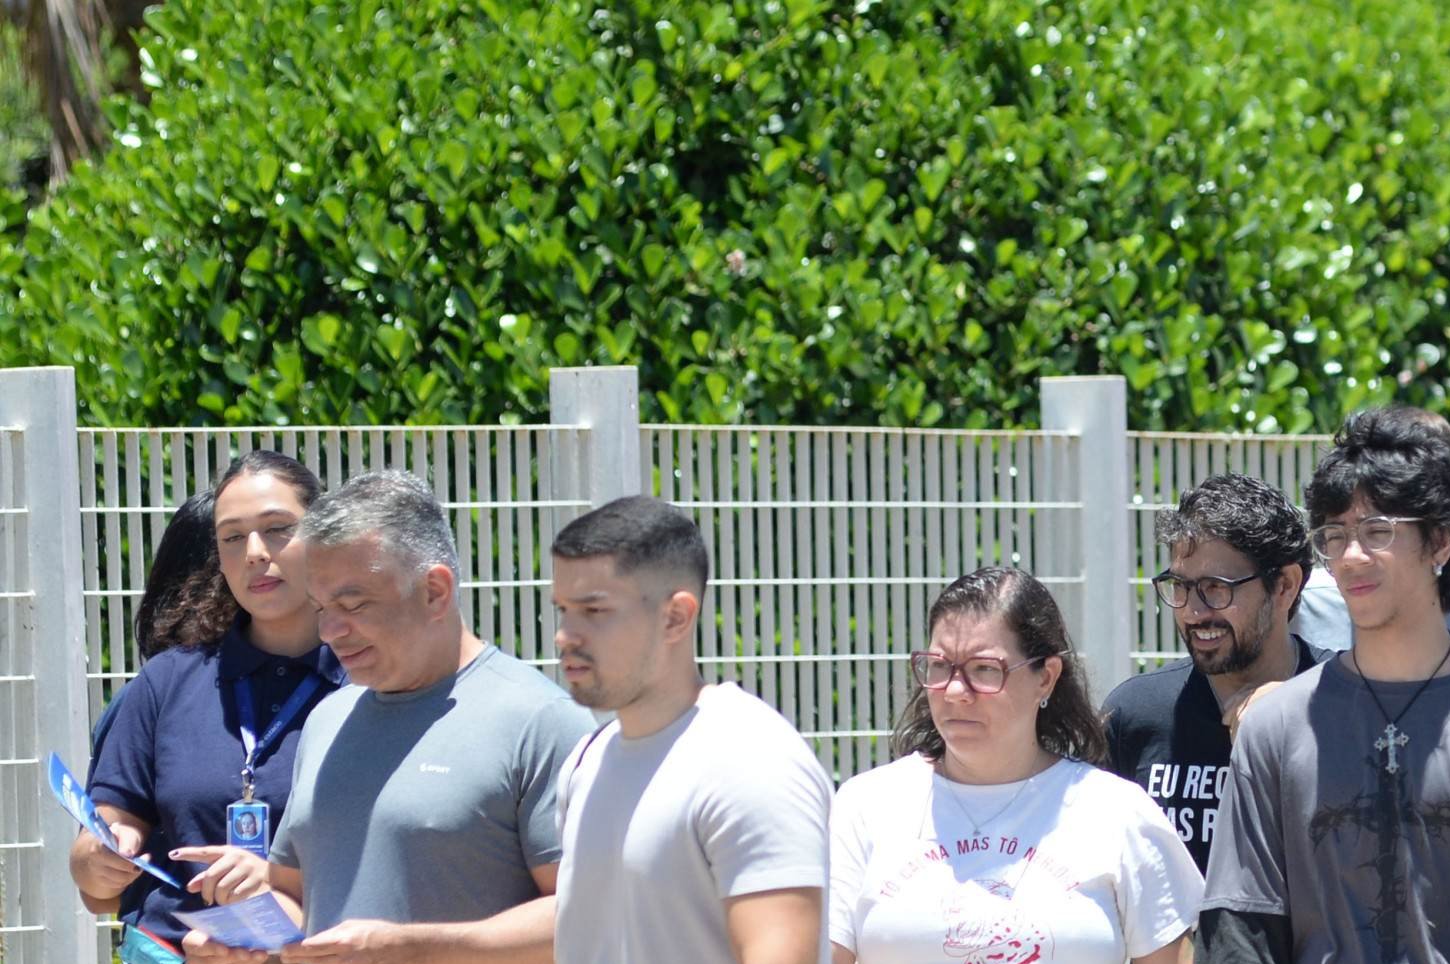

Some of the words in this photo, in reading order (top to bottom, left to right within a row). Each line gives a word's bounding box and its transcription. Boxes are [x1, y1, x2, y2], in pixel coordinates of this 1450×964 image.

[1147, 763, 1180, 799] EU
[956, 836, 990, 856] MAS
[999, 836, 1019, 856] TÔ
